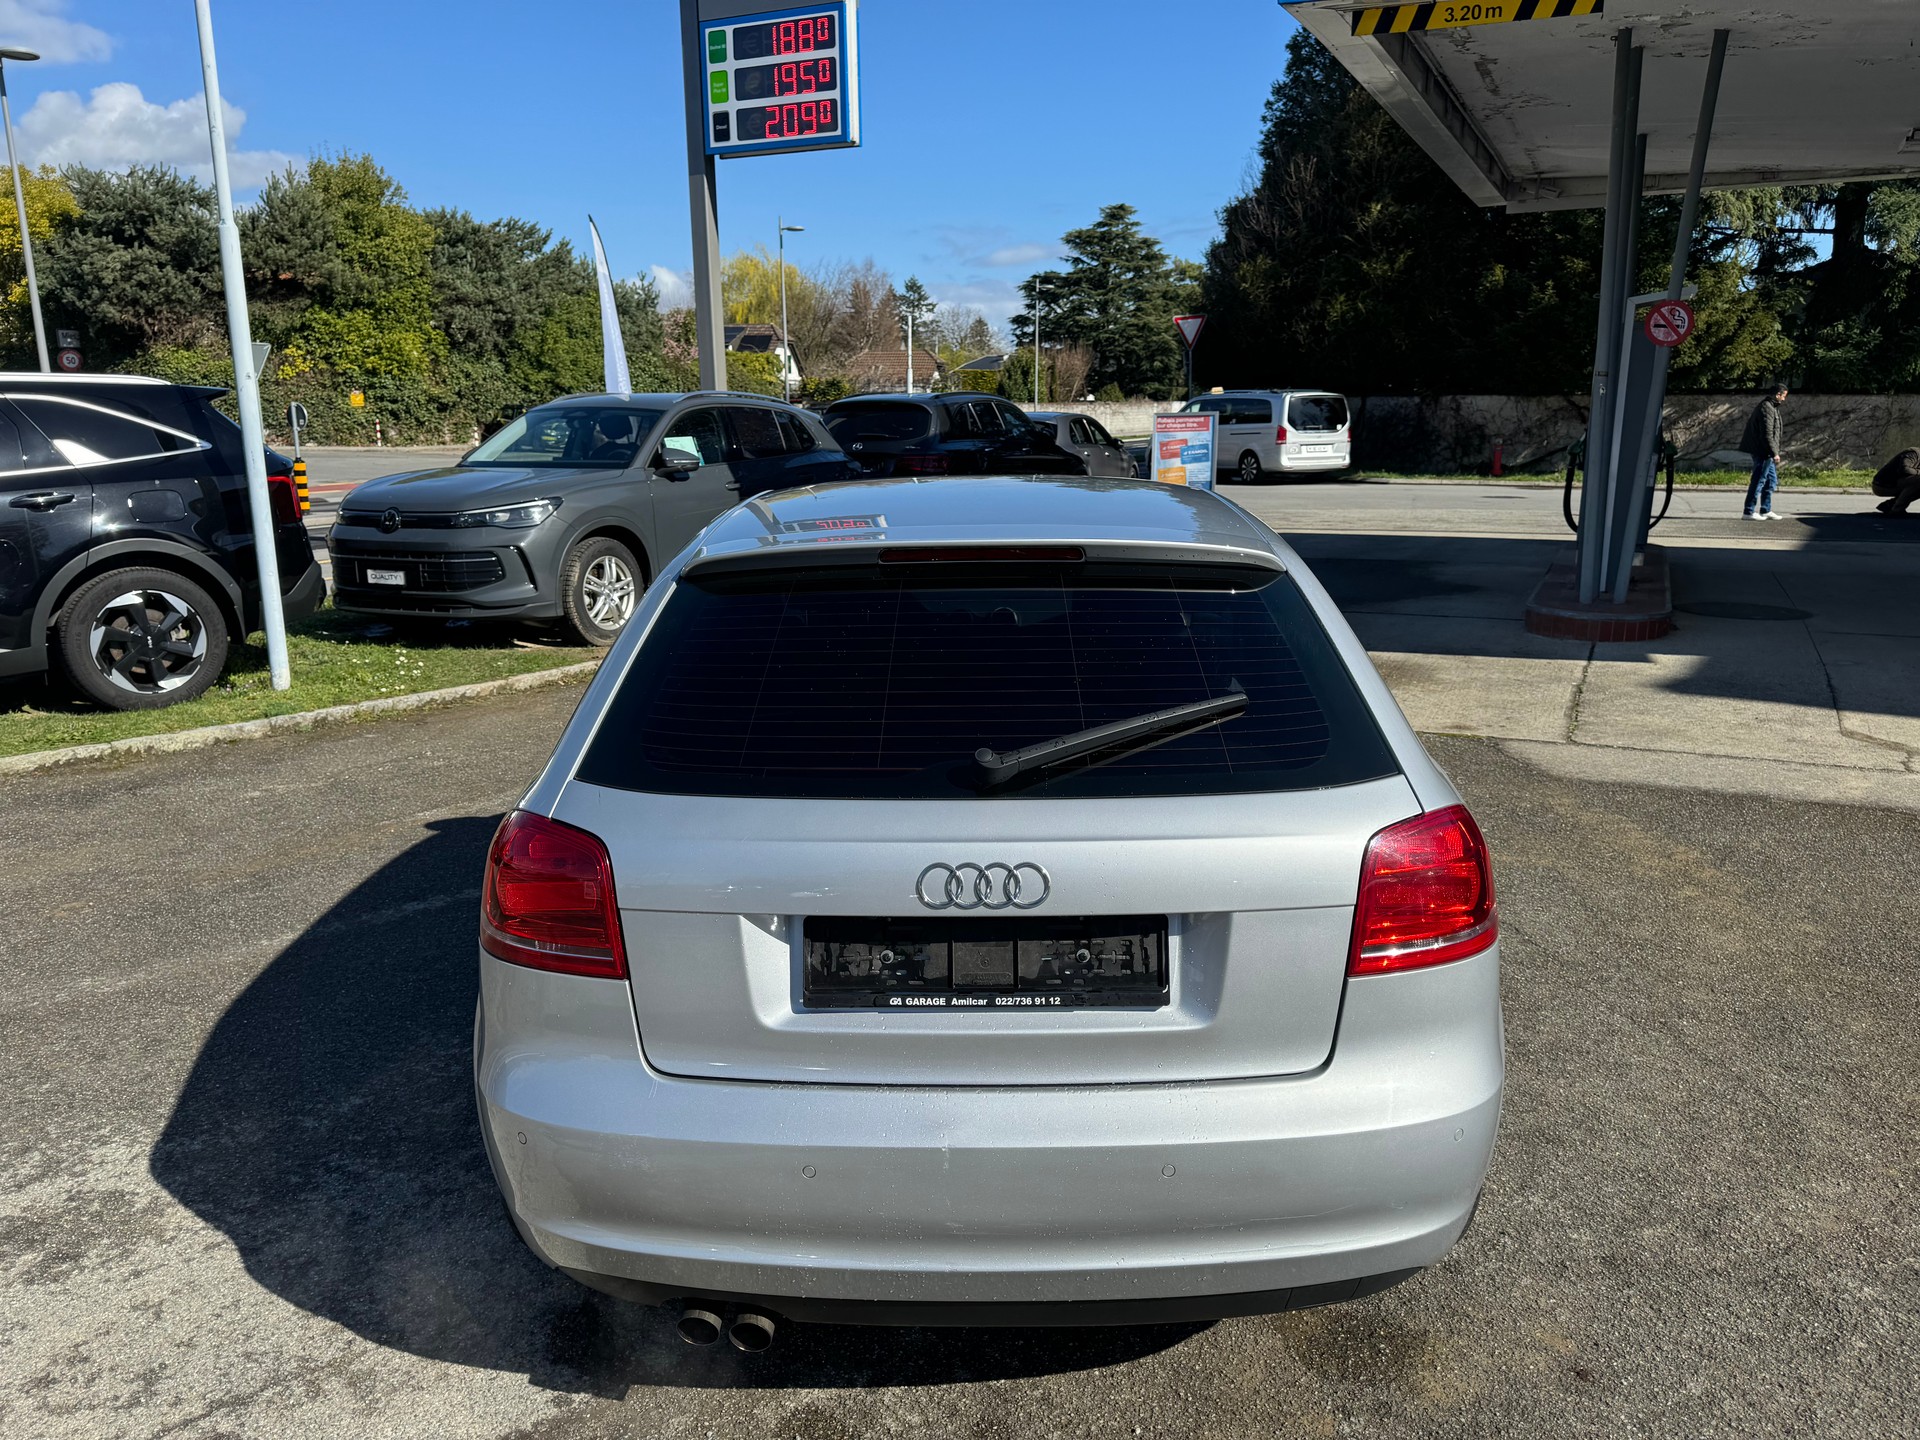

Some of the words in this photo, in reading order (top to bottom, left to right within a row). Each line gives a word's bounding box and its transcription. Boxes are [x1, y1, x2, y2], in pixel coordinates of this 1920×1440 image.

[1444, 4, 1482, 23] 3.20
[1485, 6, 1502, 19] m
[771, 17, 829, 56] 1880
[774, 59, 831, 97] 1950
[765, 100, 832, 139] 2090
[65, 356, 76, 365] 50
[905, 997, 946, 1006] GARAGE
[951, 997, 988, 1006] Amilcar
[995, 997, 1033, 1006] 022/736
[1034, 997, 1046, 1005] 91
[1049, 996, 1061, 1005] 12
